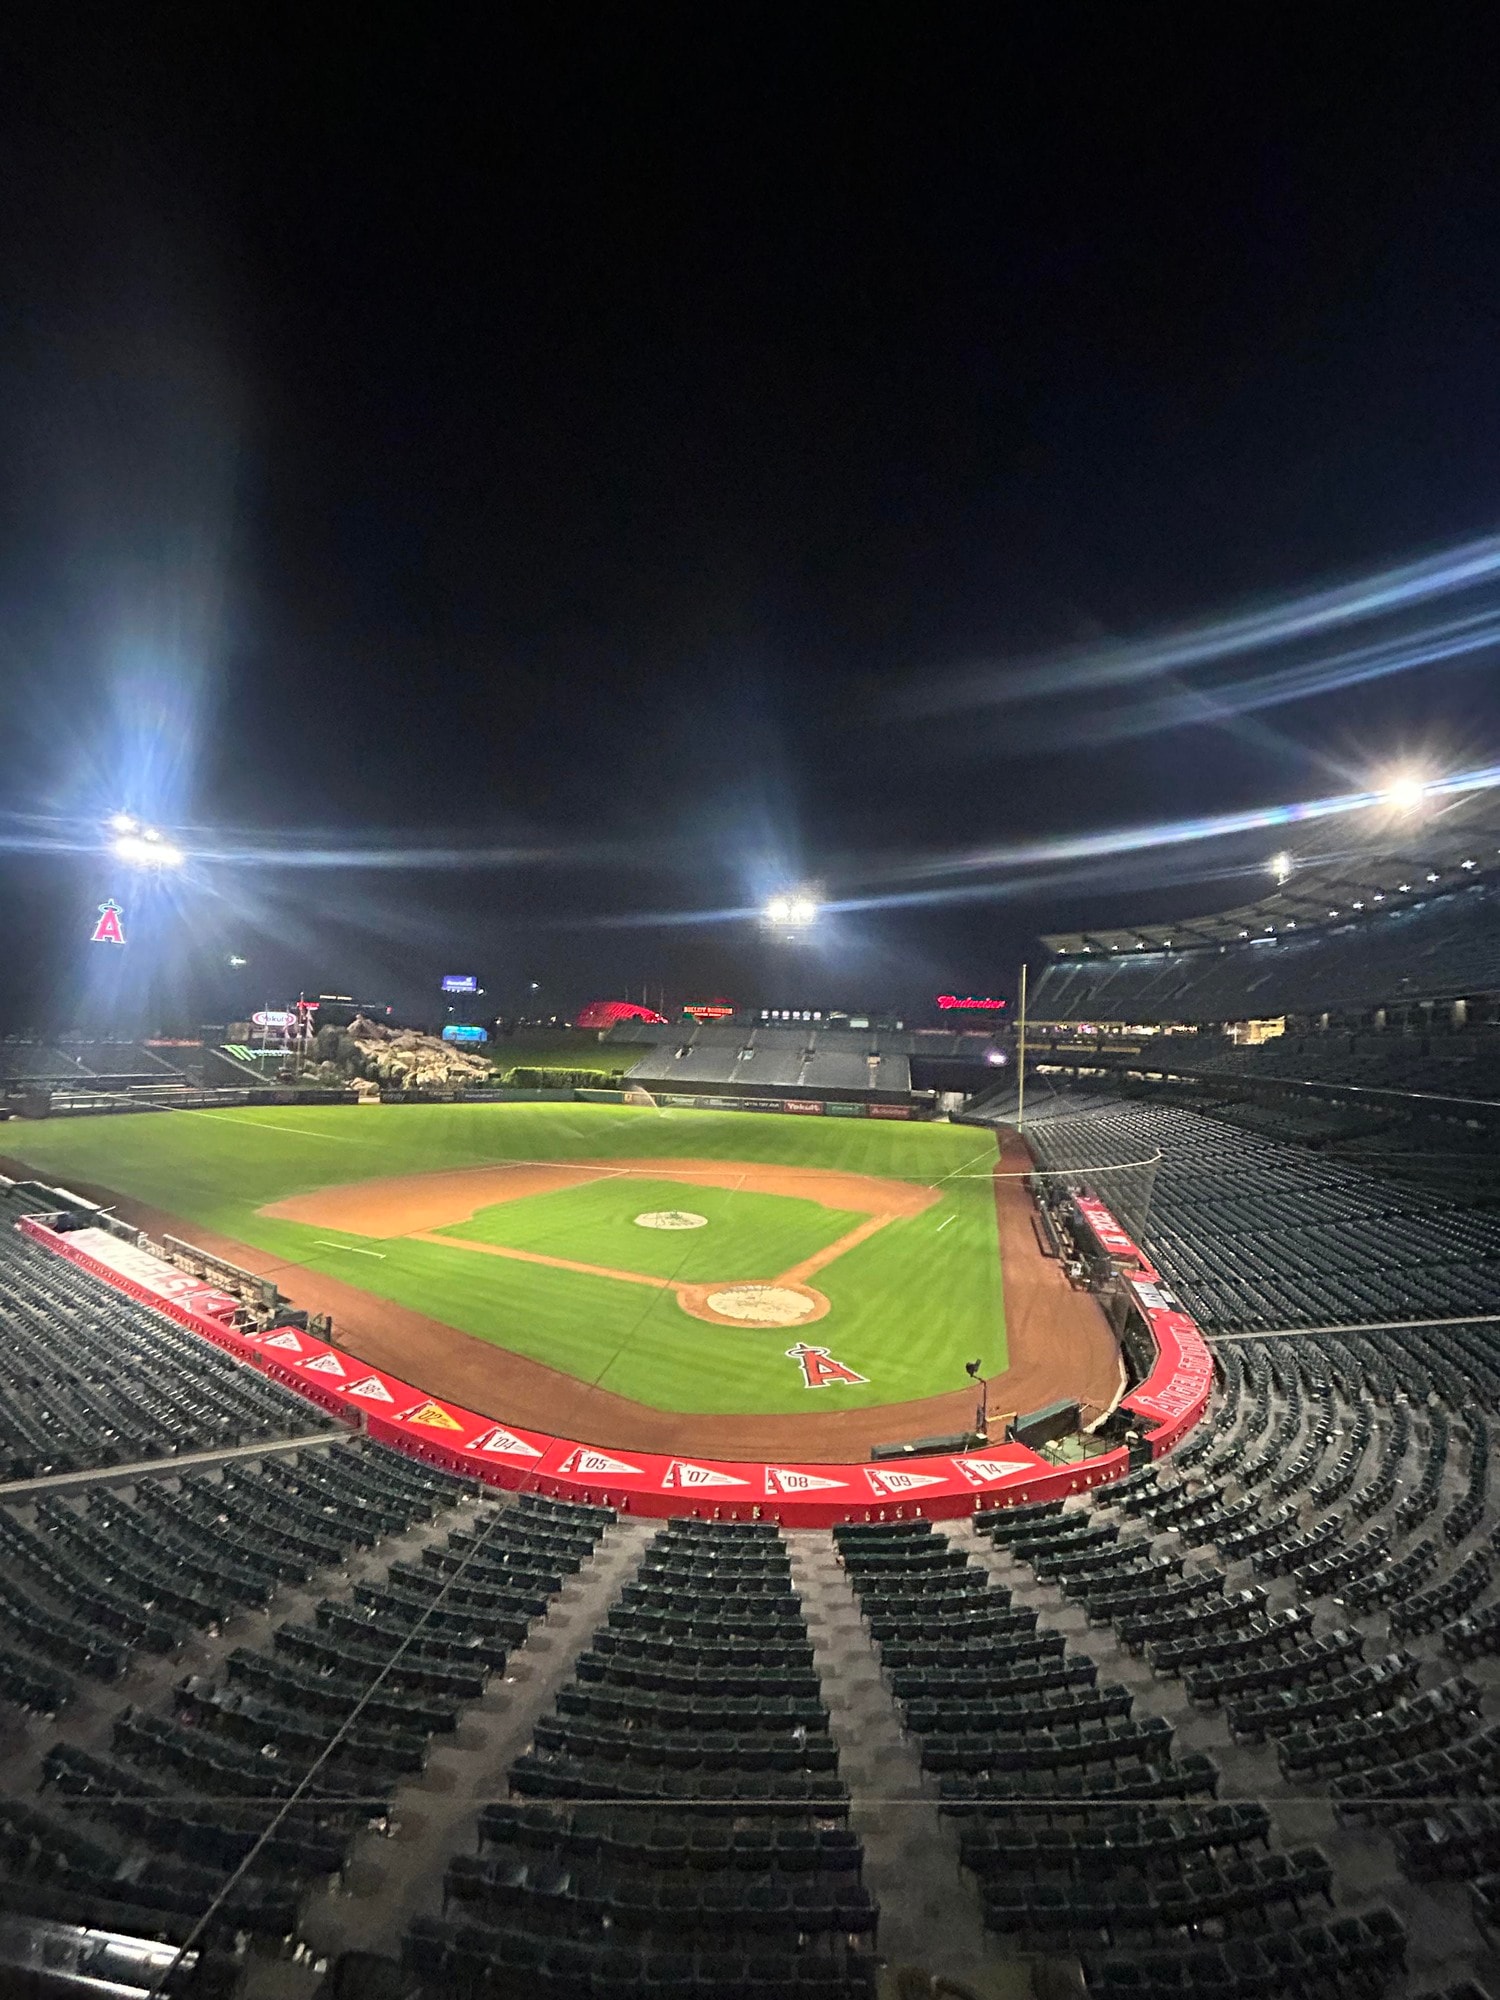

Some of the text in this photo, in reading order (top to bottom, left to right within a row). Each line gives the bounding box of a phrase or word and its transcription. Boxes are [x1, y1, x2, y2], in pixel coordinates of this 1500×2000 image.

[938, 996, 1006, 1009] Budweiser
[785, 1342, 870, 1389] A
[493, 1436, 517, 1450] '04
[586, 1456, 609, 1471] '05
[976, 1463, 1002, 1475] '14
[687, 1469, 710, 1483] '07
[784, 1476, 809, 1488] '08
[885, 1475, 912, 1487] '09
